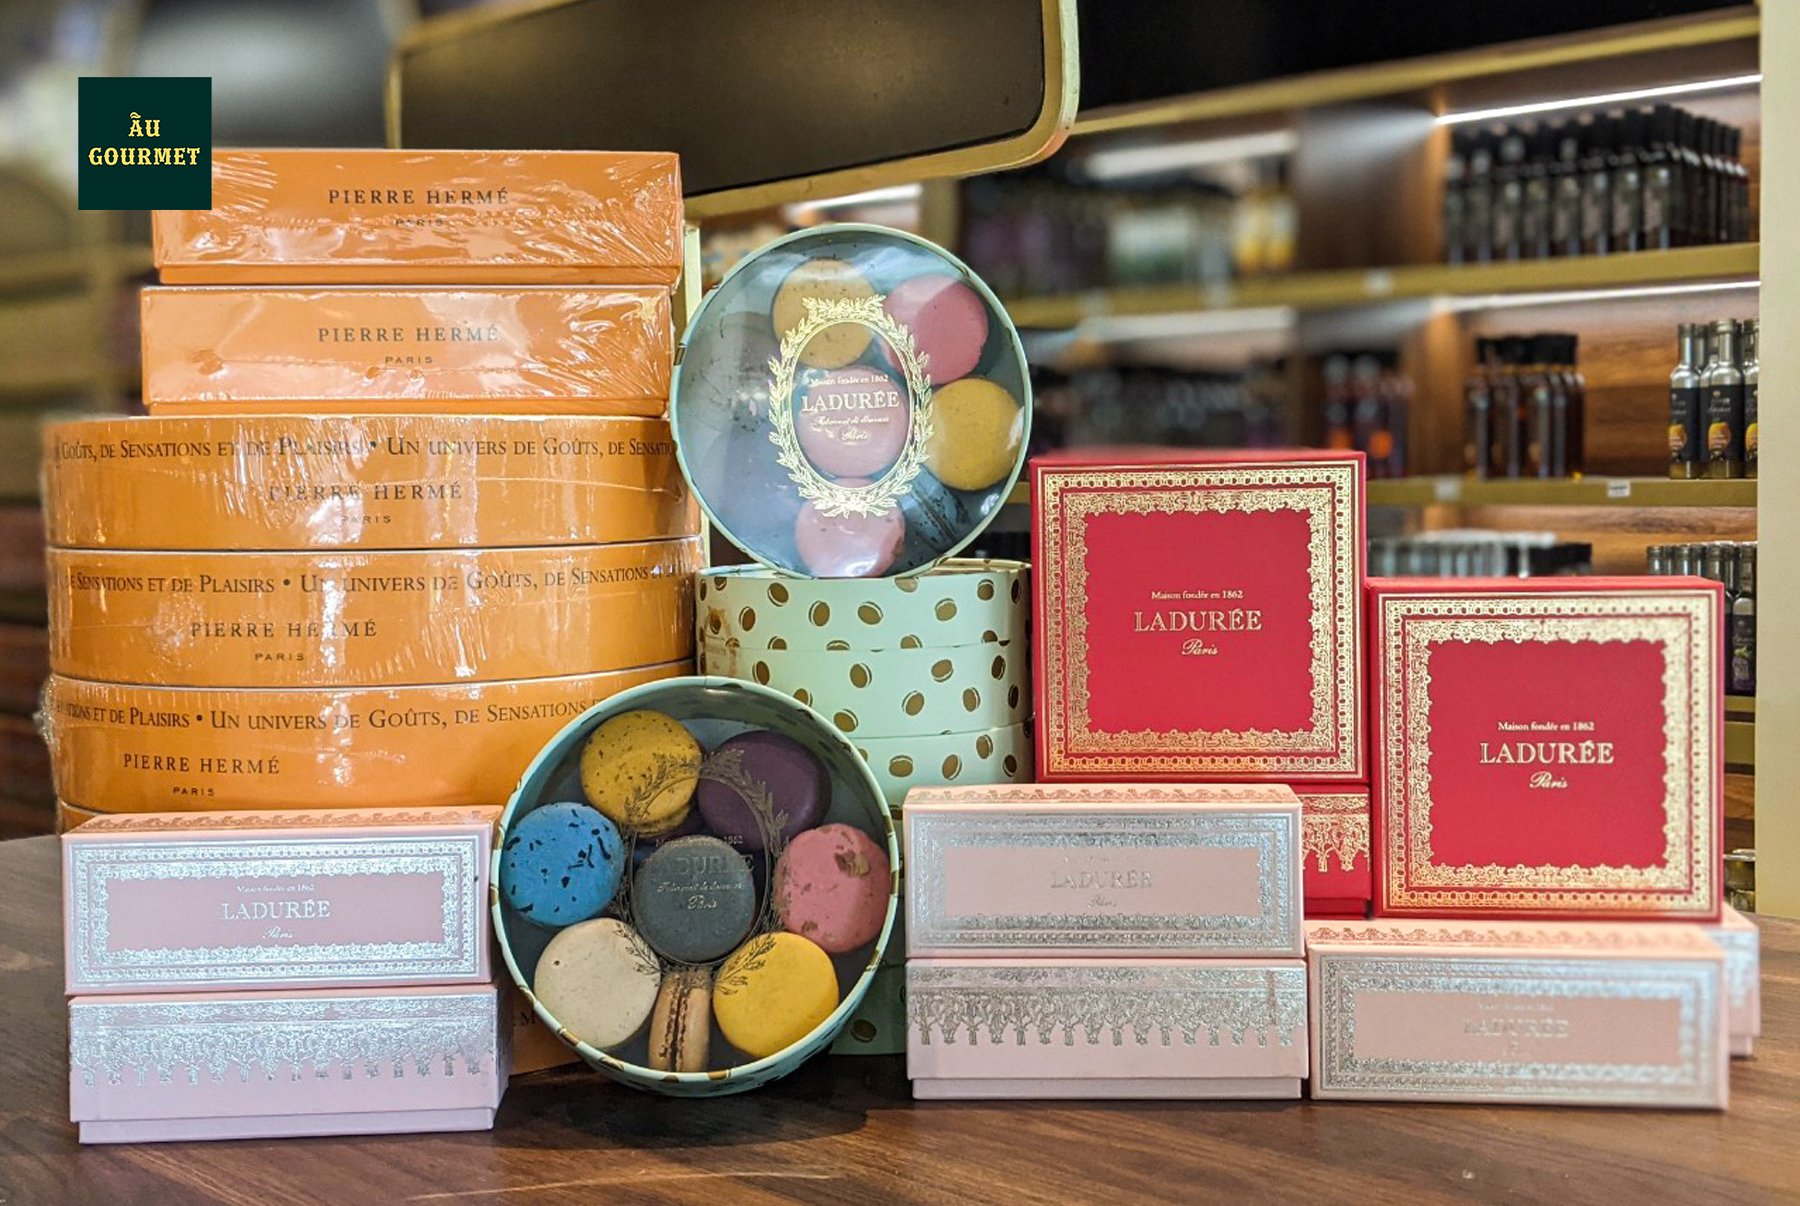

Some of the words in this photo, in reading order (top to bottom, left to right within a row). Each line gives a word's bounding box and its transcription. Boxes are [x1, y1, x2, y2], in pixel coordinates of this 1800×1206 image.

[328, 189, 415, 204] PIERRE
[427, 187, 509, 205] HERMÉ
[318, 327, 405, 342] PIERRE
[416, 324, 499, 342] HERMÉ
[385, 356, 434, 364] PARIS
[801, 391, 900, 412] LADURÉE
[100, 443, 115, 458] DE
[120, 439, 211, 458] SENSATIONS
[386, 436, 420, 455] UN
[429, 440, 507, 456] UNIVERS
[513, 440, 536, 455] DE
[608, 441, 625, 455] DE
[374, 482, 462, 500] HERMÉ
[148, 577, 166, 592] ET
[171, 578, 193, 592] DE
[200, 574, 275, 593] PLAISIRS
[343, 577, 425, 592] UNIVERS
[433, 576, 459, 591] DE
[544, 571, 565, 587] DE
[571, 566, 649, 585] SENSATIONS
[1151, 591, 1181, 600] Maison
[1182, 590, 1208, 600] fondée
[1222, 590, 1244, 599] 1862
[191, 622, 274, 638] PIERRE
[288, 619, 377, 638] HEMÉ
[1134, 608, 1263, 632] LADURÉE
[254, 652, 305, 661] PARIS
[1181, 638, 1219, 656] Paris
[94, 707, 106, 722] ET
[109, 708, 126, 724] DE
[129, 707, 190, 728] PLAISIRS
[211, 710, 240, 729] UN
[248, 713, 327, 730] UNIVERS
[334, 712, 360, 729] DE
[455, 709, 480, 725] DE
[486, 701, 587, 723] SENSATIONS
[1498, 721, 1529, 731] Maison
[1530, 721, 1558, 731] fondée
[1572, 721, 1595, 731] 1862
[1479, 740, 1614, 764] LADURÉE
[123, 753, 190, 772] PIERRE
[200, 755, 280, 775] HERMÉ
[1529, 770, 1568, 789] Paris
[173, 786, 215, 797] PARIS
[222, 899, 331, 920] LADURÉE
